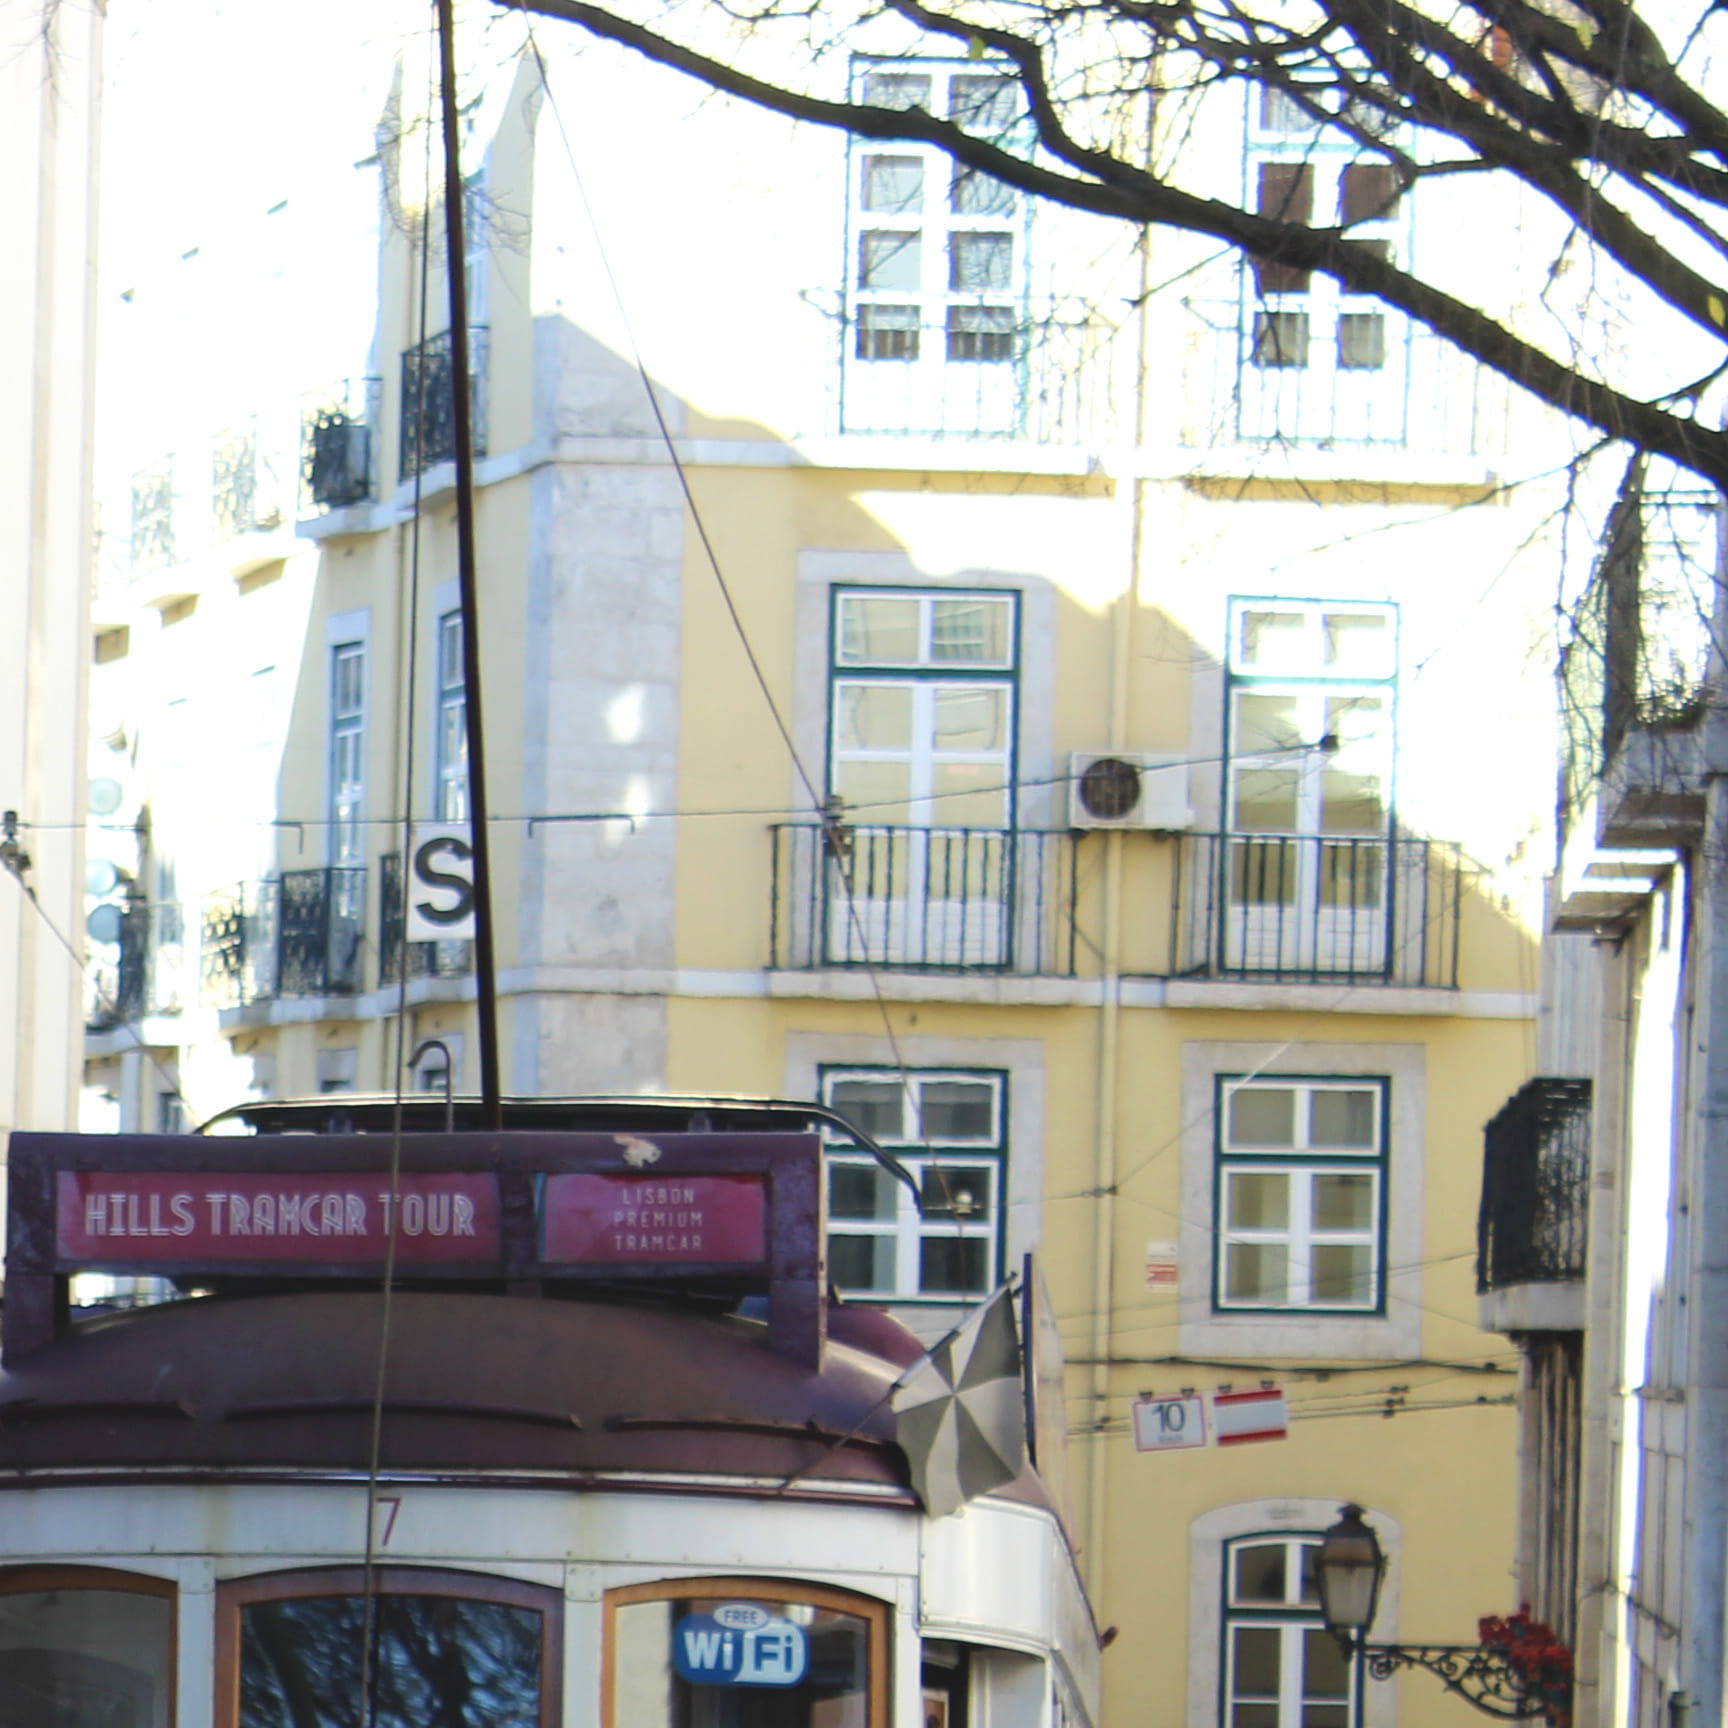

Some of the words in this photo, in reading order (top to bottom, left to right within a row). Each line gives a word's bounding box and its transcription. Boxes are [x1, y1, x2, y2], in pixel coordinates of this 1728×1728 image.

[414, 837, 475, 927] S
[622, 1187, 696, 1205] LISBON
[84, 1193, 196, 1237] HILLS
[206, 1193, 369, 1237] TRAMCAR
[378, 1193, 477, 1237] TOUR
[613, 1211, 704, 1228] PREMIUM
[613, 1234, 704, 1252] TRAMCAR
[1152, 1402, 1186, 1433] 10
[376, 1496, 402, 1548] 7
[723, 1609, 759, 1625] FREE
